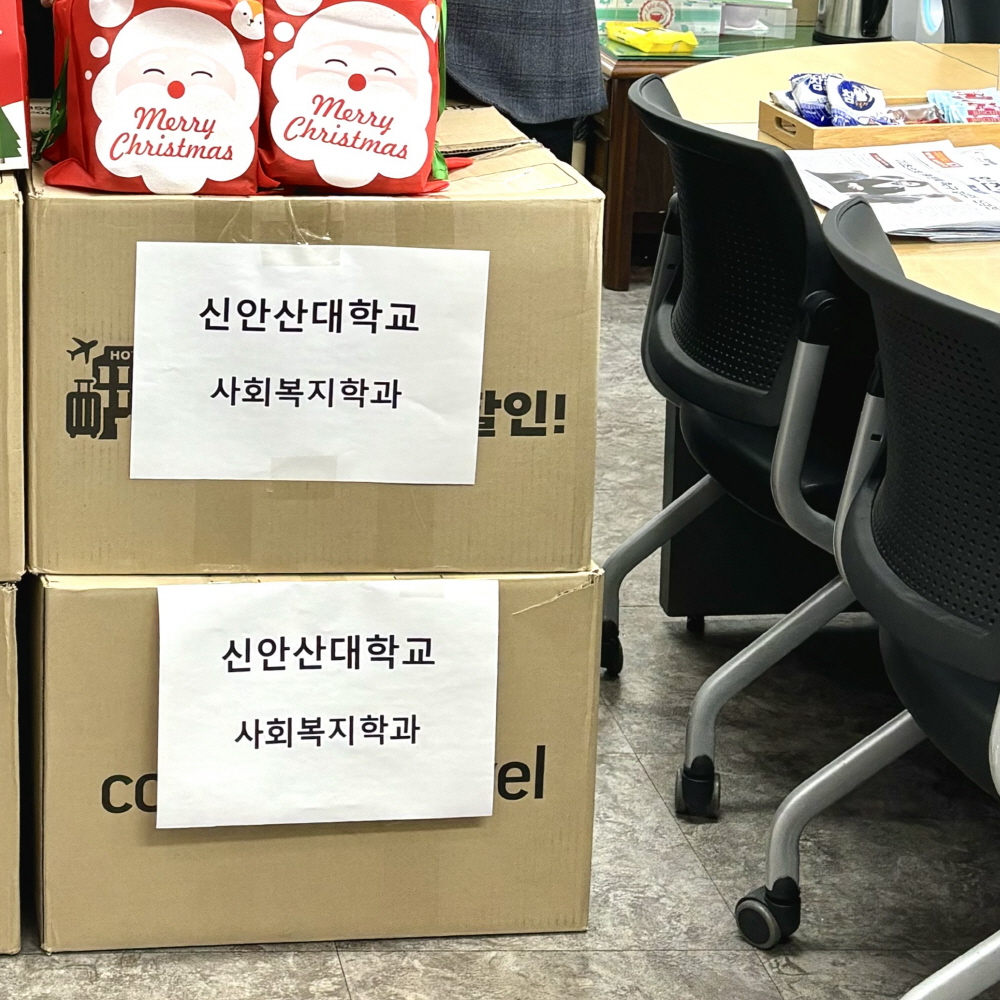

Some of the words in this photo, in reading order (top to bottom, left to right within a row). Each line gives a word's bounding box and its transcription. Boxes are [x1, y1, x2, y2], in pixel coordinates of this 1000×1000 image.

[134, 107, 216, 139] Merry
[312, 94, 394, 131] Merry
[109, 132, 233, 161] Christmas
[283, 117, 408, 160] Christmas
[199, 297, 420, 334] 신안산대학교
[110, 350, 133, 360] HO
[210, 376, 402, 409] 사회복지학과
[221, 634, 436, 673] 신안산대학교
[234, 714, 421, 750] 사회복지학과
